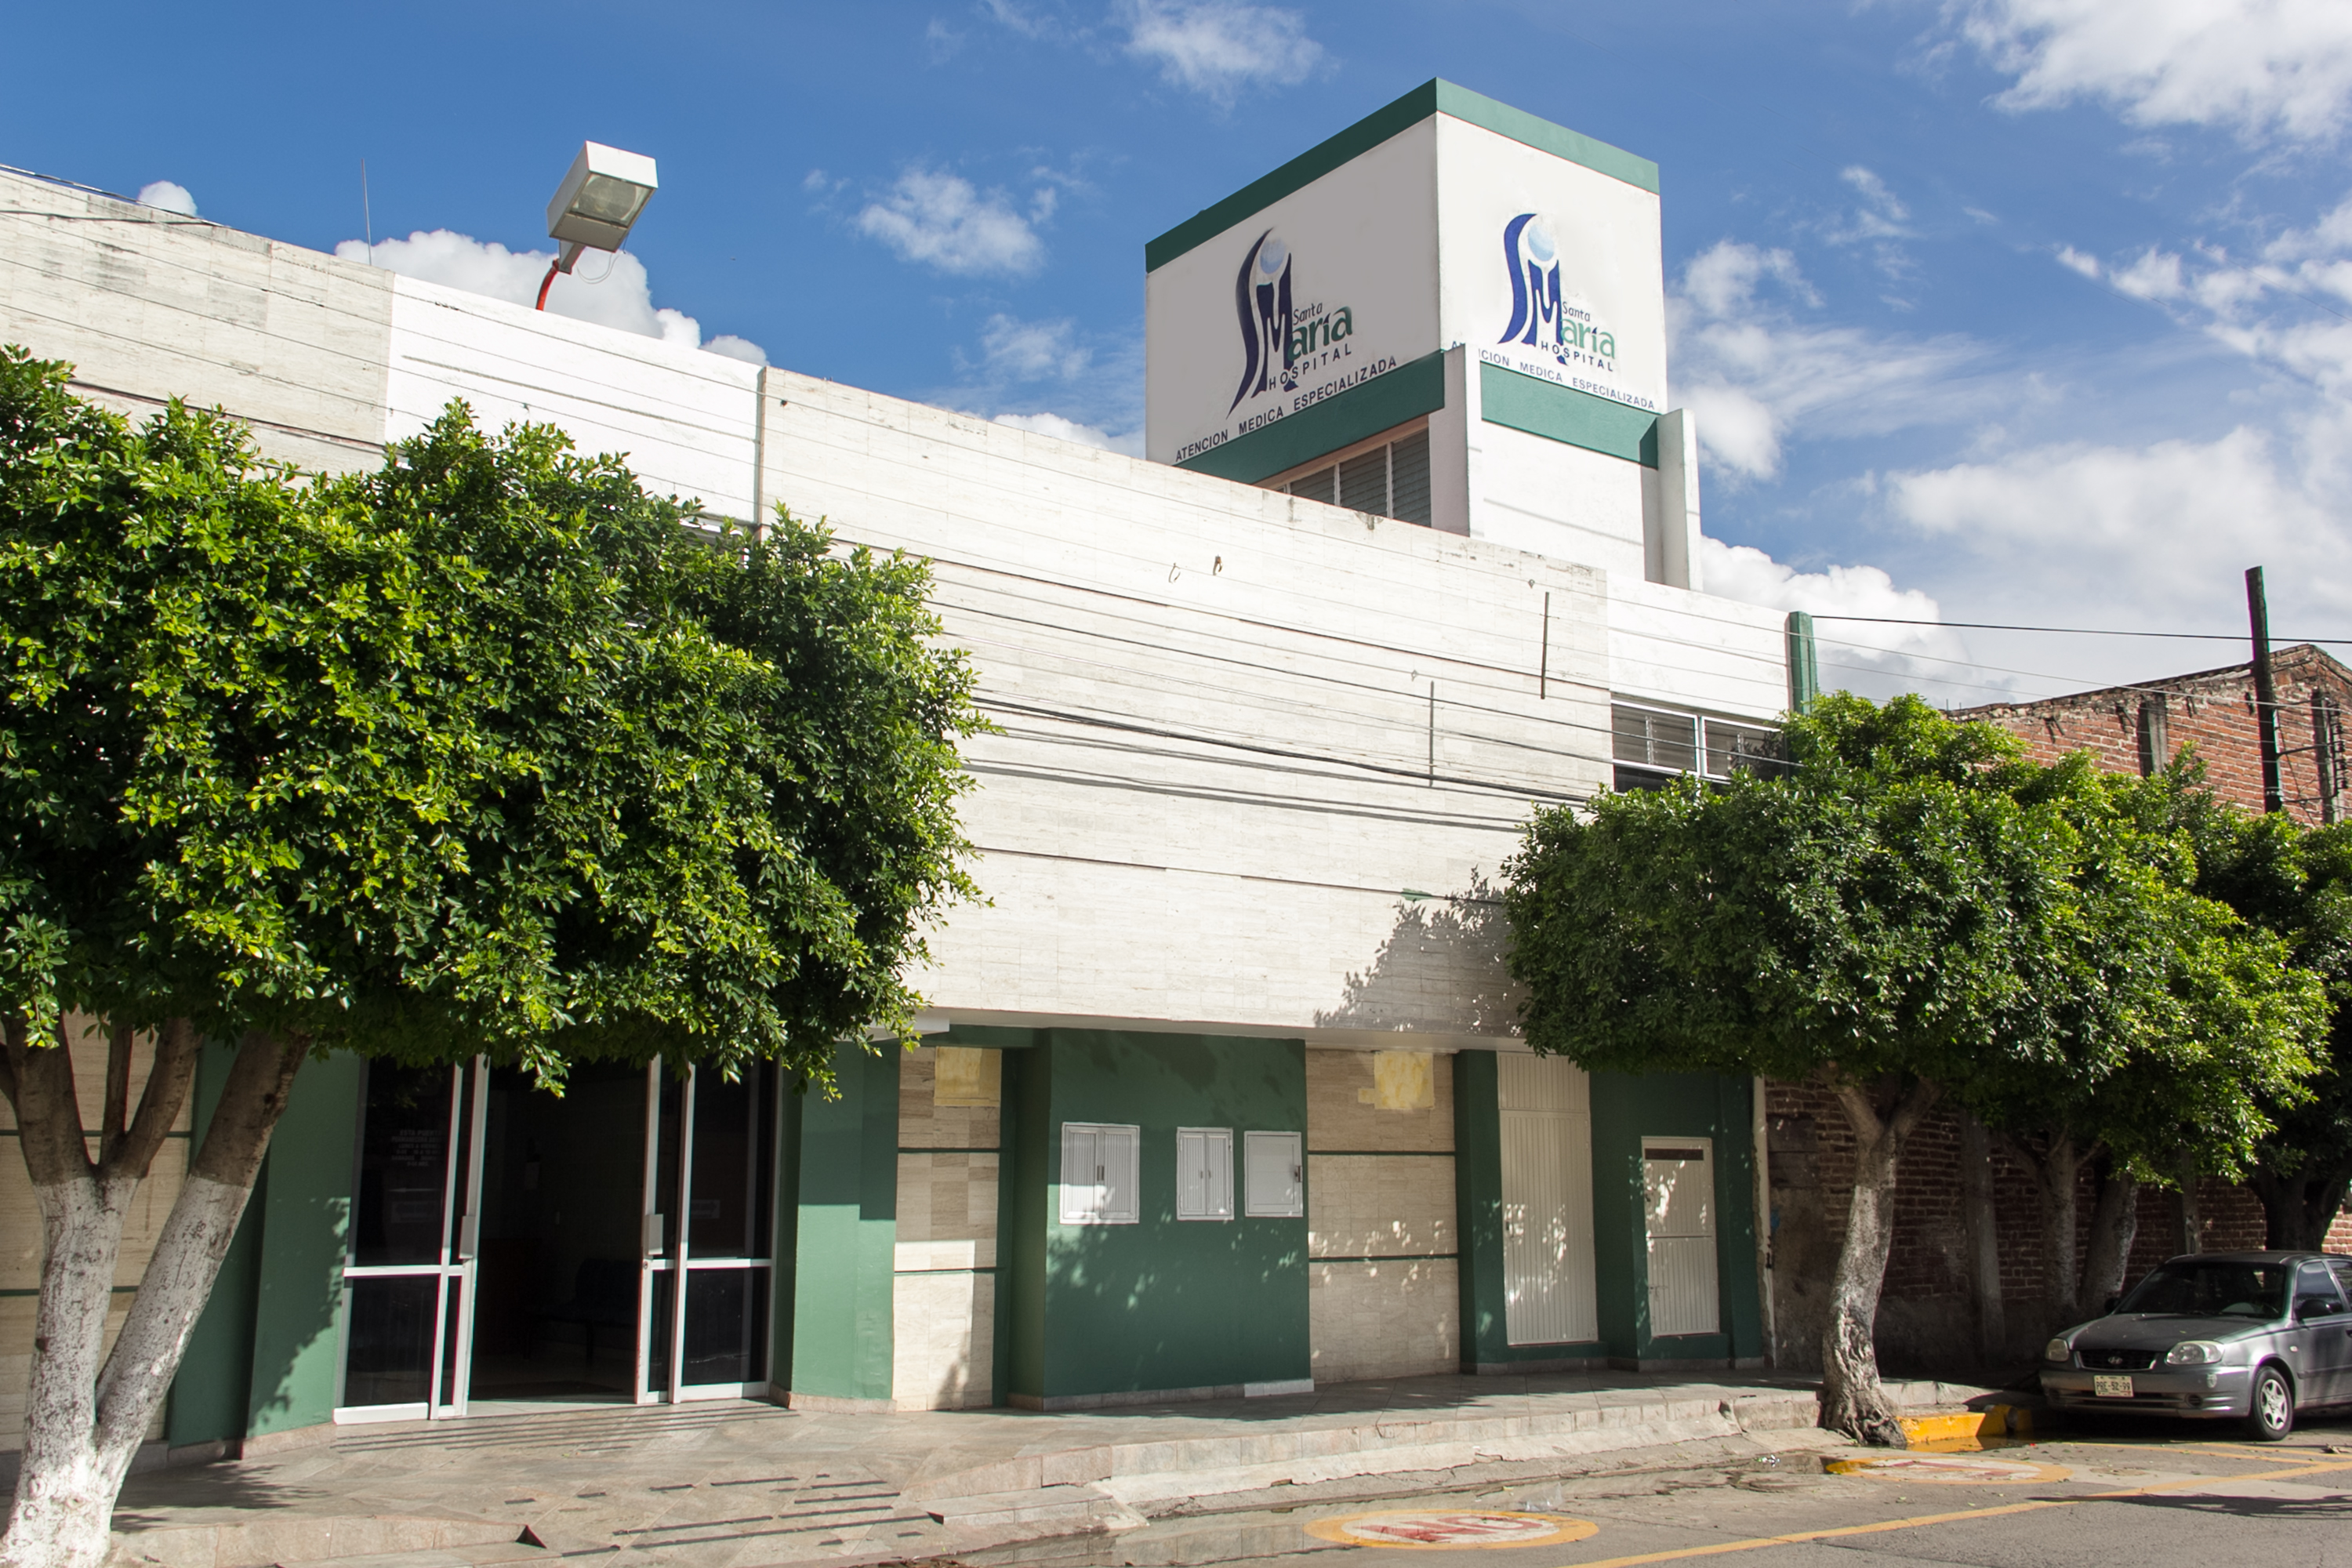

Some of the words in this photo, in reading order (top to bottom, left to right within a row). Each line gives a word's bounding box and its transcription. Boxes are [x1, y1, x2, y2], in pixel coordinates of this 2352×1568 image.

[1293, 302, 1323, 325] Santa
[1563, 301, 1591, 322] Santa
[1269, 343, 1352, 390] HOSPITAL
[1541, 340, 1614, 372] HOSPITAL
[1519, 361, 1563, 383] MEDICA
[1573, 377, 1655, 410] ESPECIALIZADA
[1175, 429, 1229, 463] ATENCION
[1239, 405, 1283, 435] MEDICA
[1294, 355, 1397, 411] ESPECIALIZADA
